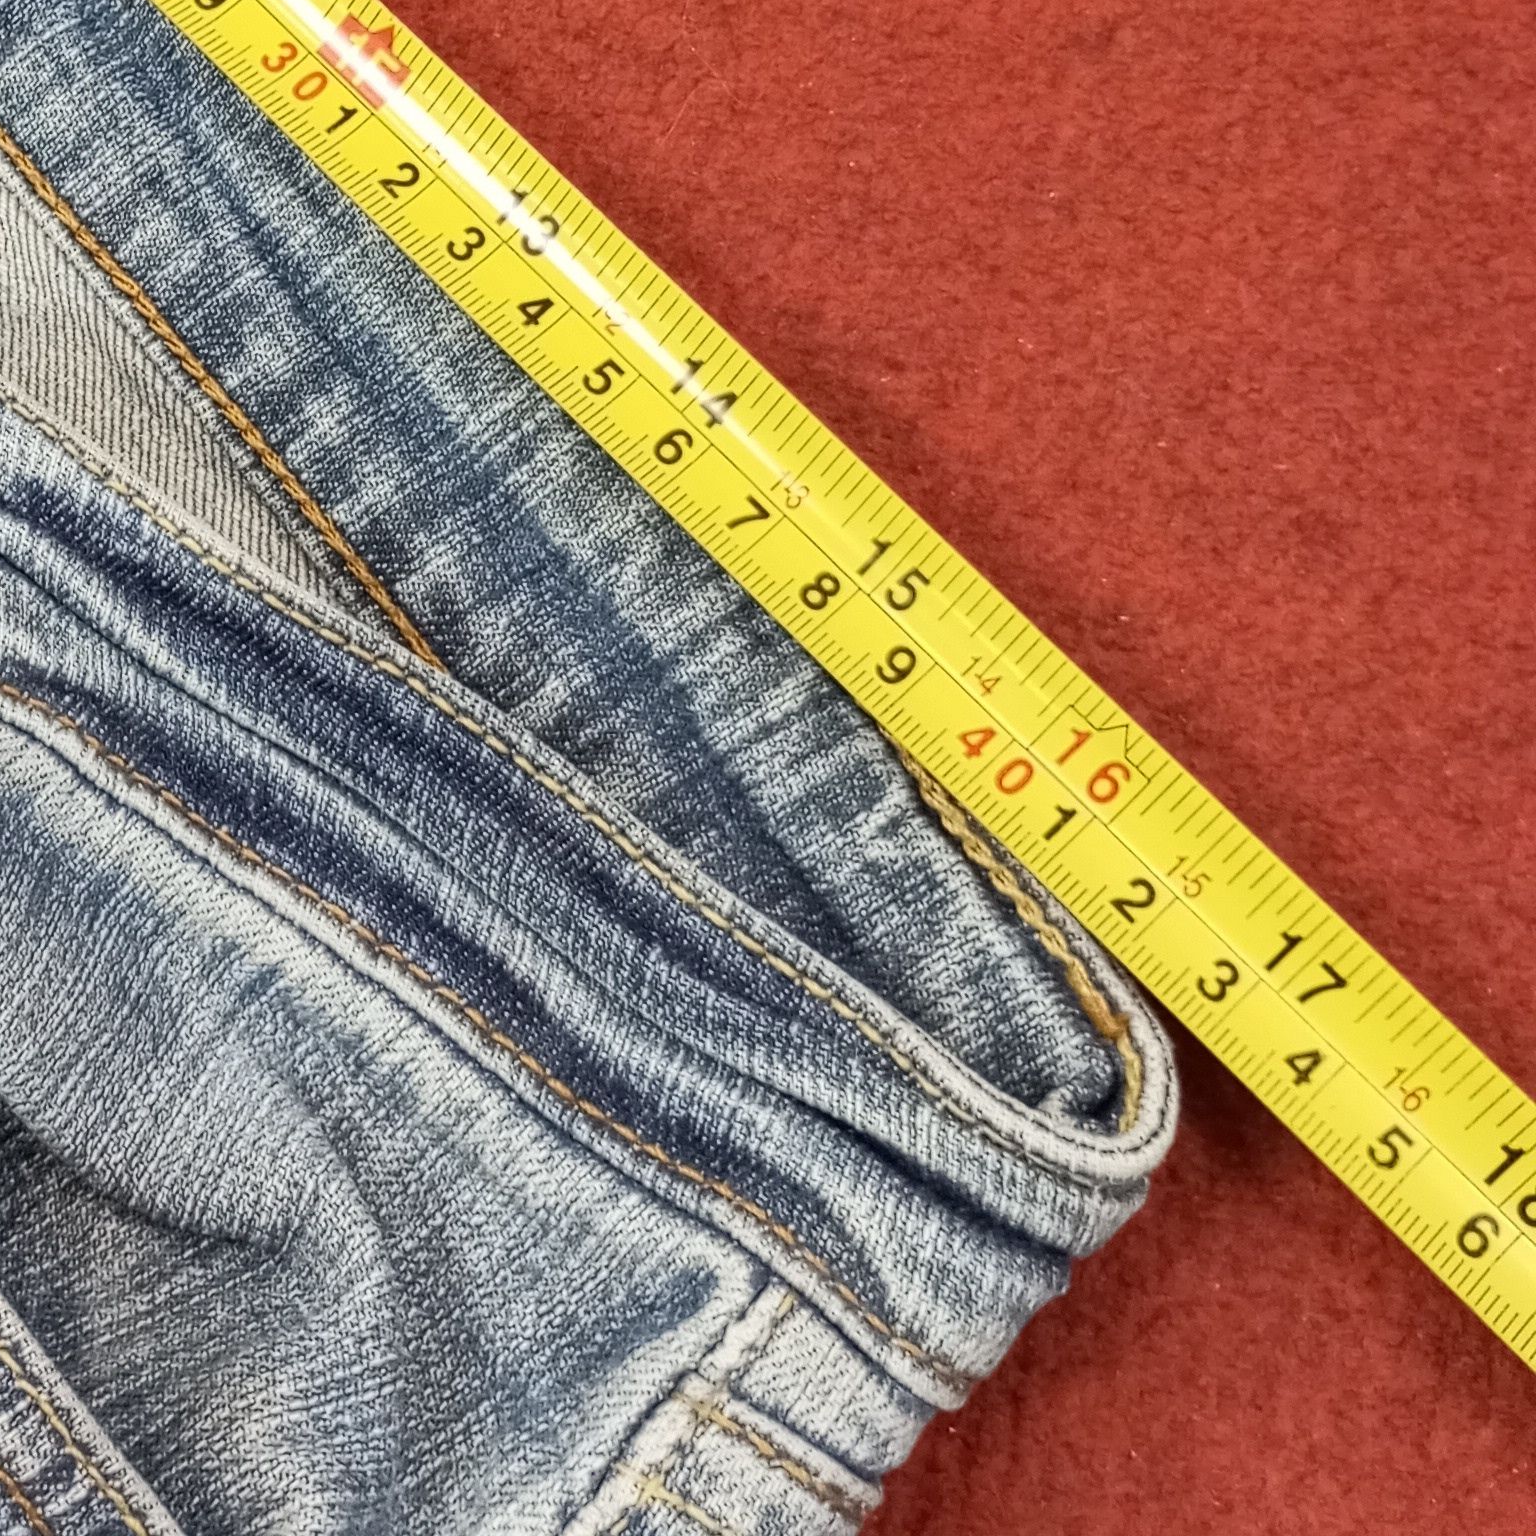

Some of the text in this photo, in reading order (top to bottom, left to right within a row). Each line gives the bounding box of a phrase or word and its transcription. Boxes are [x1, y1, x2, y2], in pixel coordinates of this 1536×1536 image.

[262, 41, 329, 103] 30
[323, 104, 359, 136] 1
[378, 161, 421, 199] 2
[446, 226, 486, 261] 3
[517, 296, 554, 327] 4
[582, 358, 626, 396] 5
[653, 427, 694, 466] 6
[727, 495, 771, 531] 7
[798, 571, 842, 612] 8
[875, 645, 918, 686] 9
[958, 725, 1035, 797] 40
[1042, 804, 1078, 842] 1
[1110, 877, 1157, 924] 2
[1195, 958, 1241, 1003] 3
[1284, 1048, 1326, 1087] 4
[1366, 1123, 1415, 1170] 5
[1456, 1211, 1500, 1260] 6
[669, 356, 739, 430] 14
[855, 535, 932, 613] 15
[1054, 726, 1133, 806] 16
[1264, 930, 1348, 1005] 17
